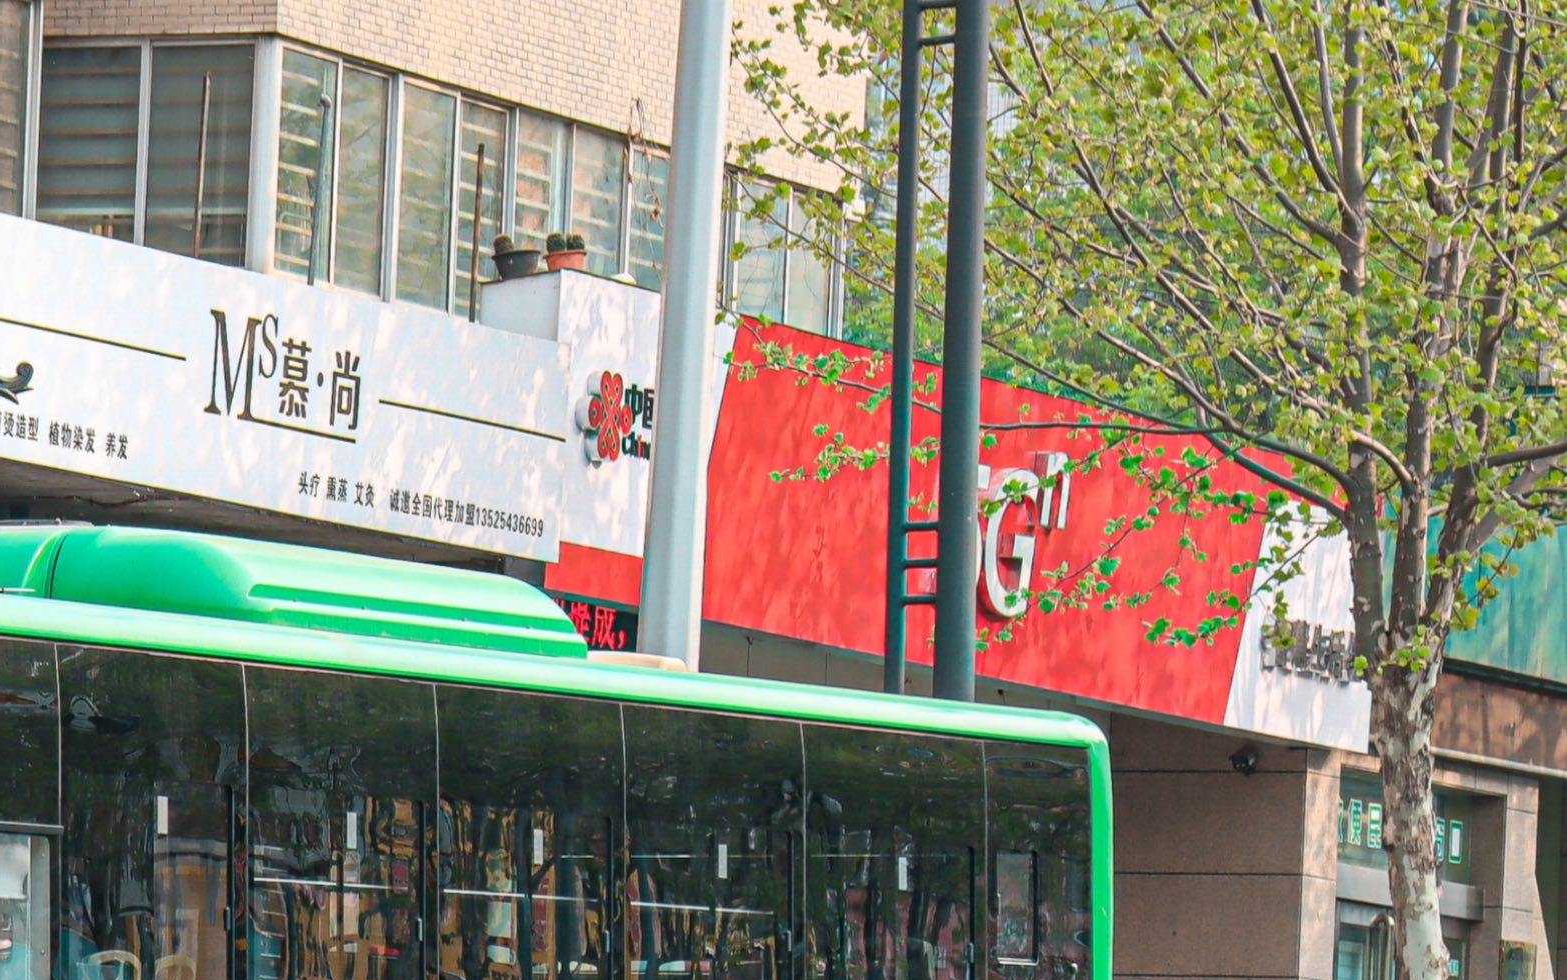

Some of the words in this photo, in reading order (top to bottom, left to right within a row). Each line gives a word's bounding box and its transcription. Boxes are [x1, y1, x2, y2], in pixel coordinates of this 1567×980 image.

[49, 420, 96, 454] 植物染发
[105, 431, 129, 460] 养发
[298, 471, 321, 499] 头疗
[354, 481, 375, 508] 艾灸
